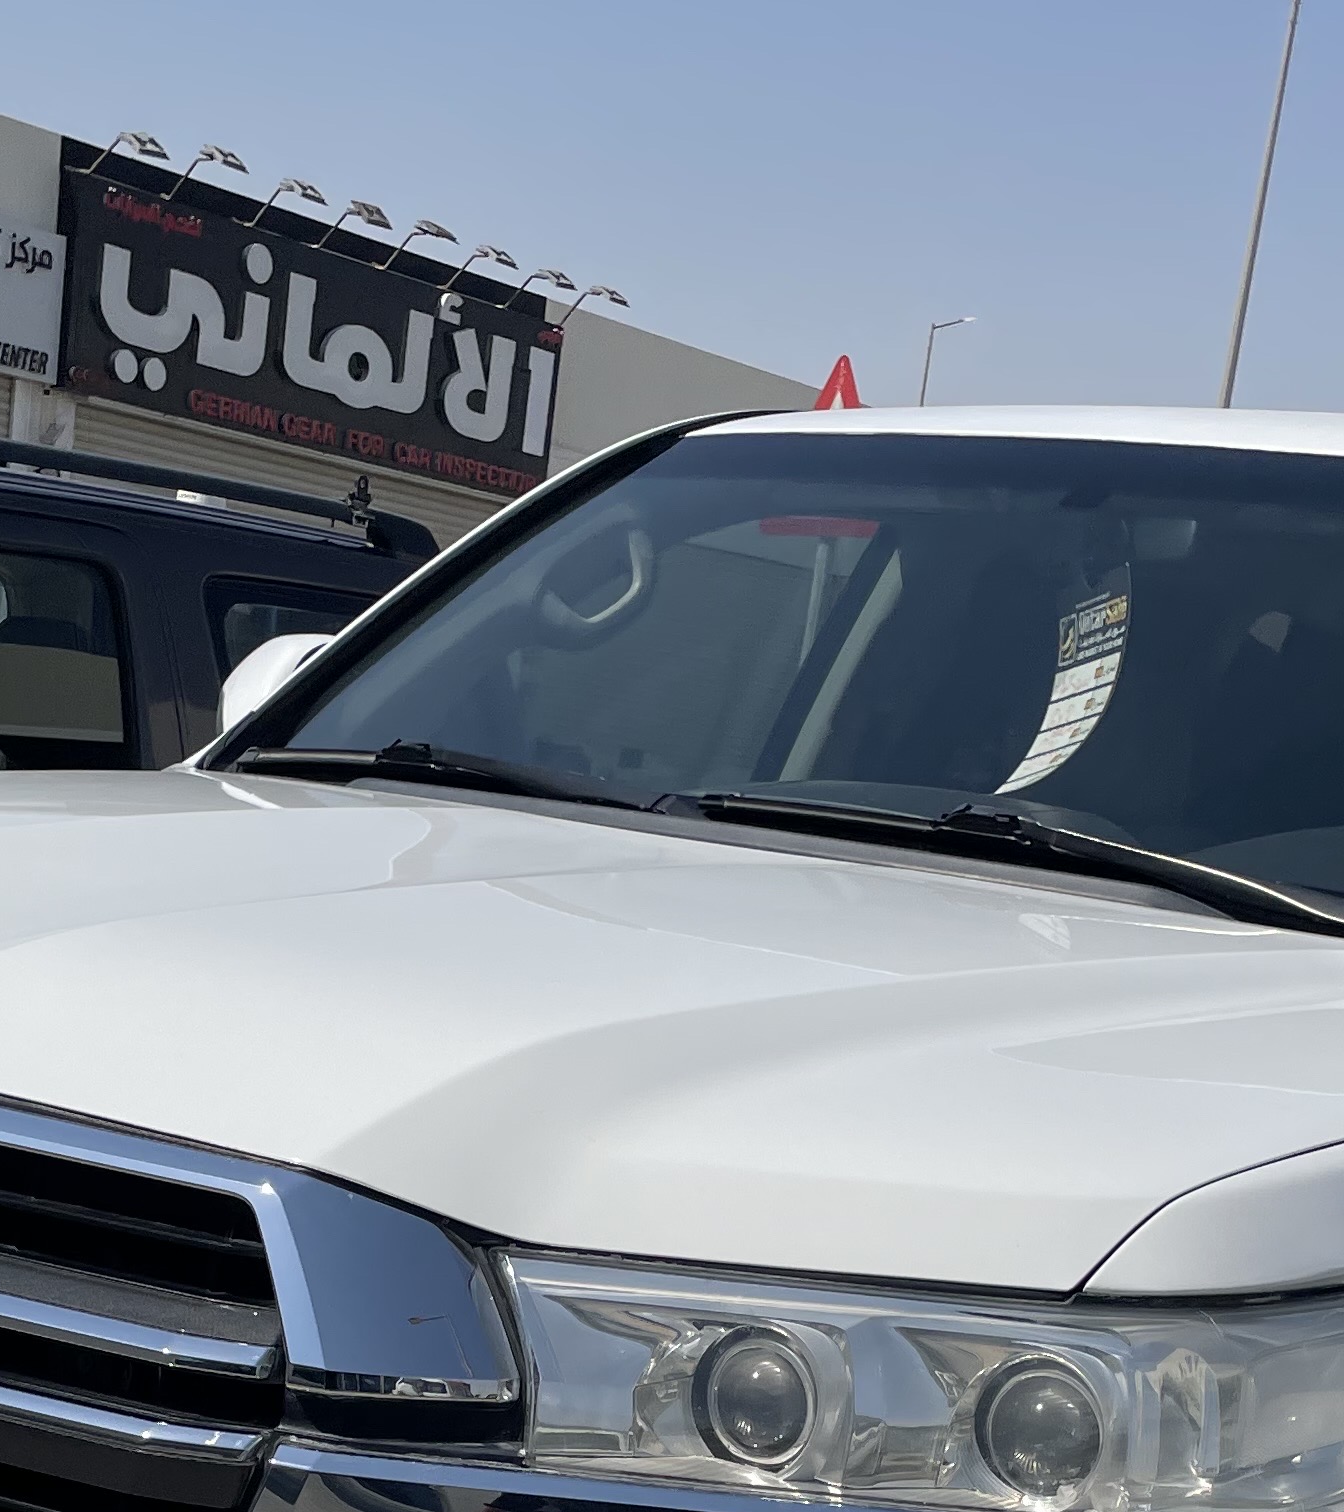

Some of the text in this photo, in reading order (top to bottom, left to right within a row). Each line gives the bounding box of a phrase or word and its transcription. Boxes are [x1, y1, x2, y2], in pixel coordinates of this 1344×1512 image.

[4, 233, 54, 274] مركز
[99, 241, 558, 458] الألماني
[188, 388, 279, 433] GERMAN
[280, 412, 337, 447] GEAR
[344, 428, 386, 459] FOR
[393, 440, 433, 471] CAR
